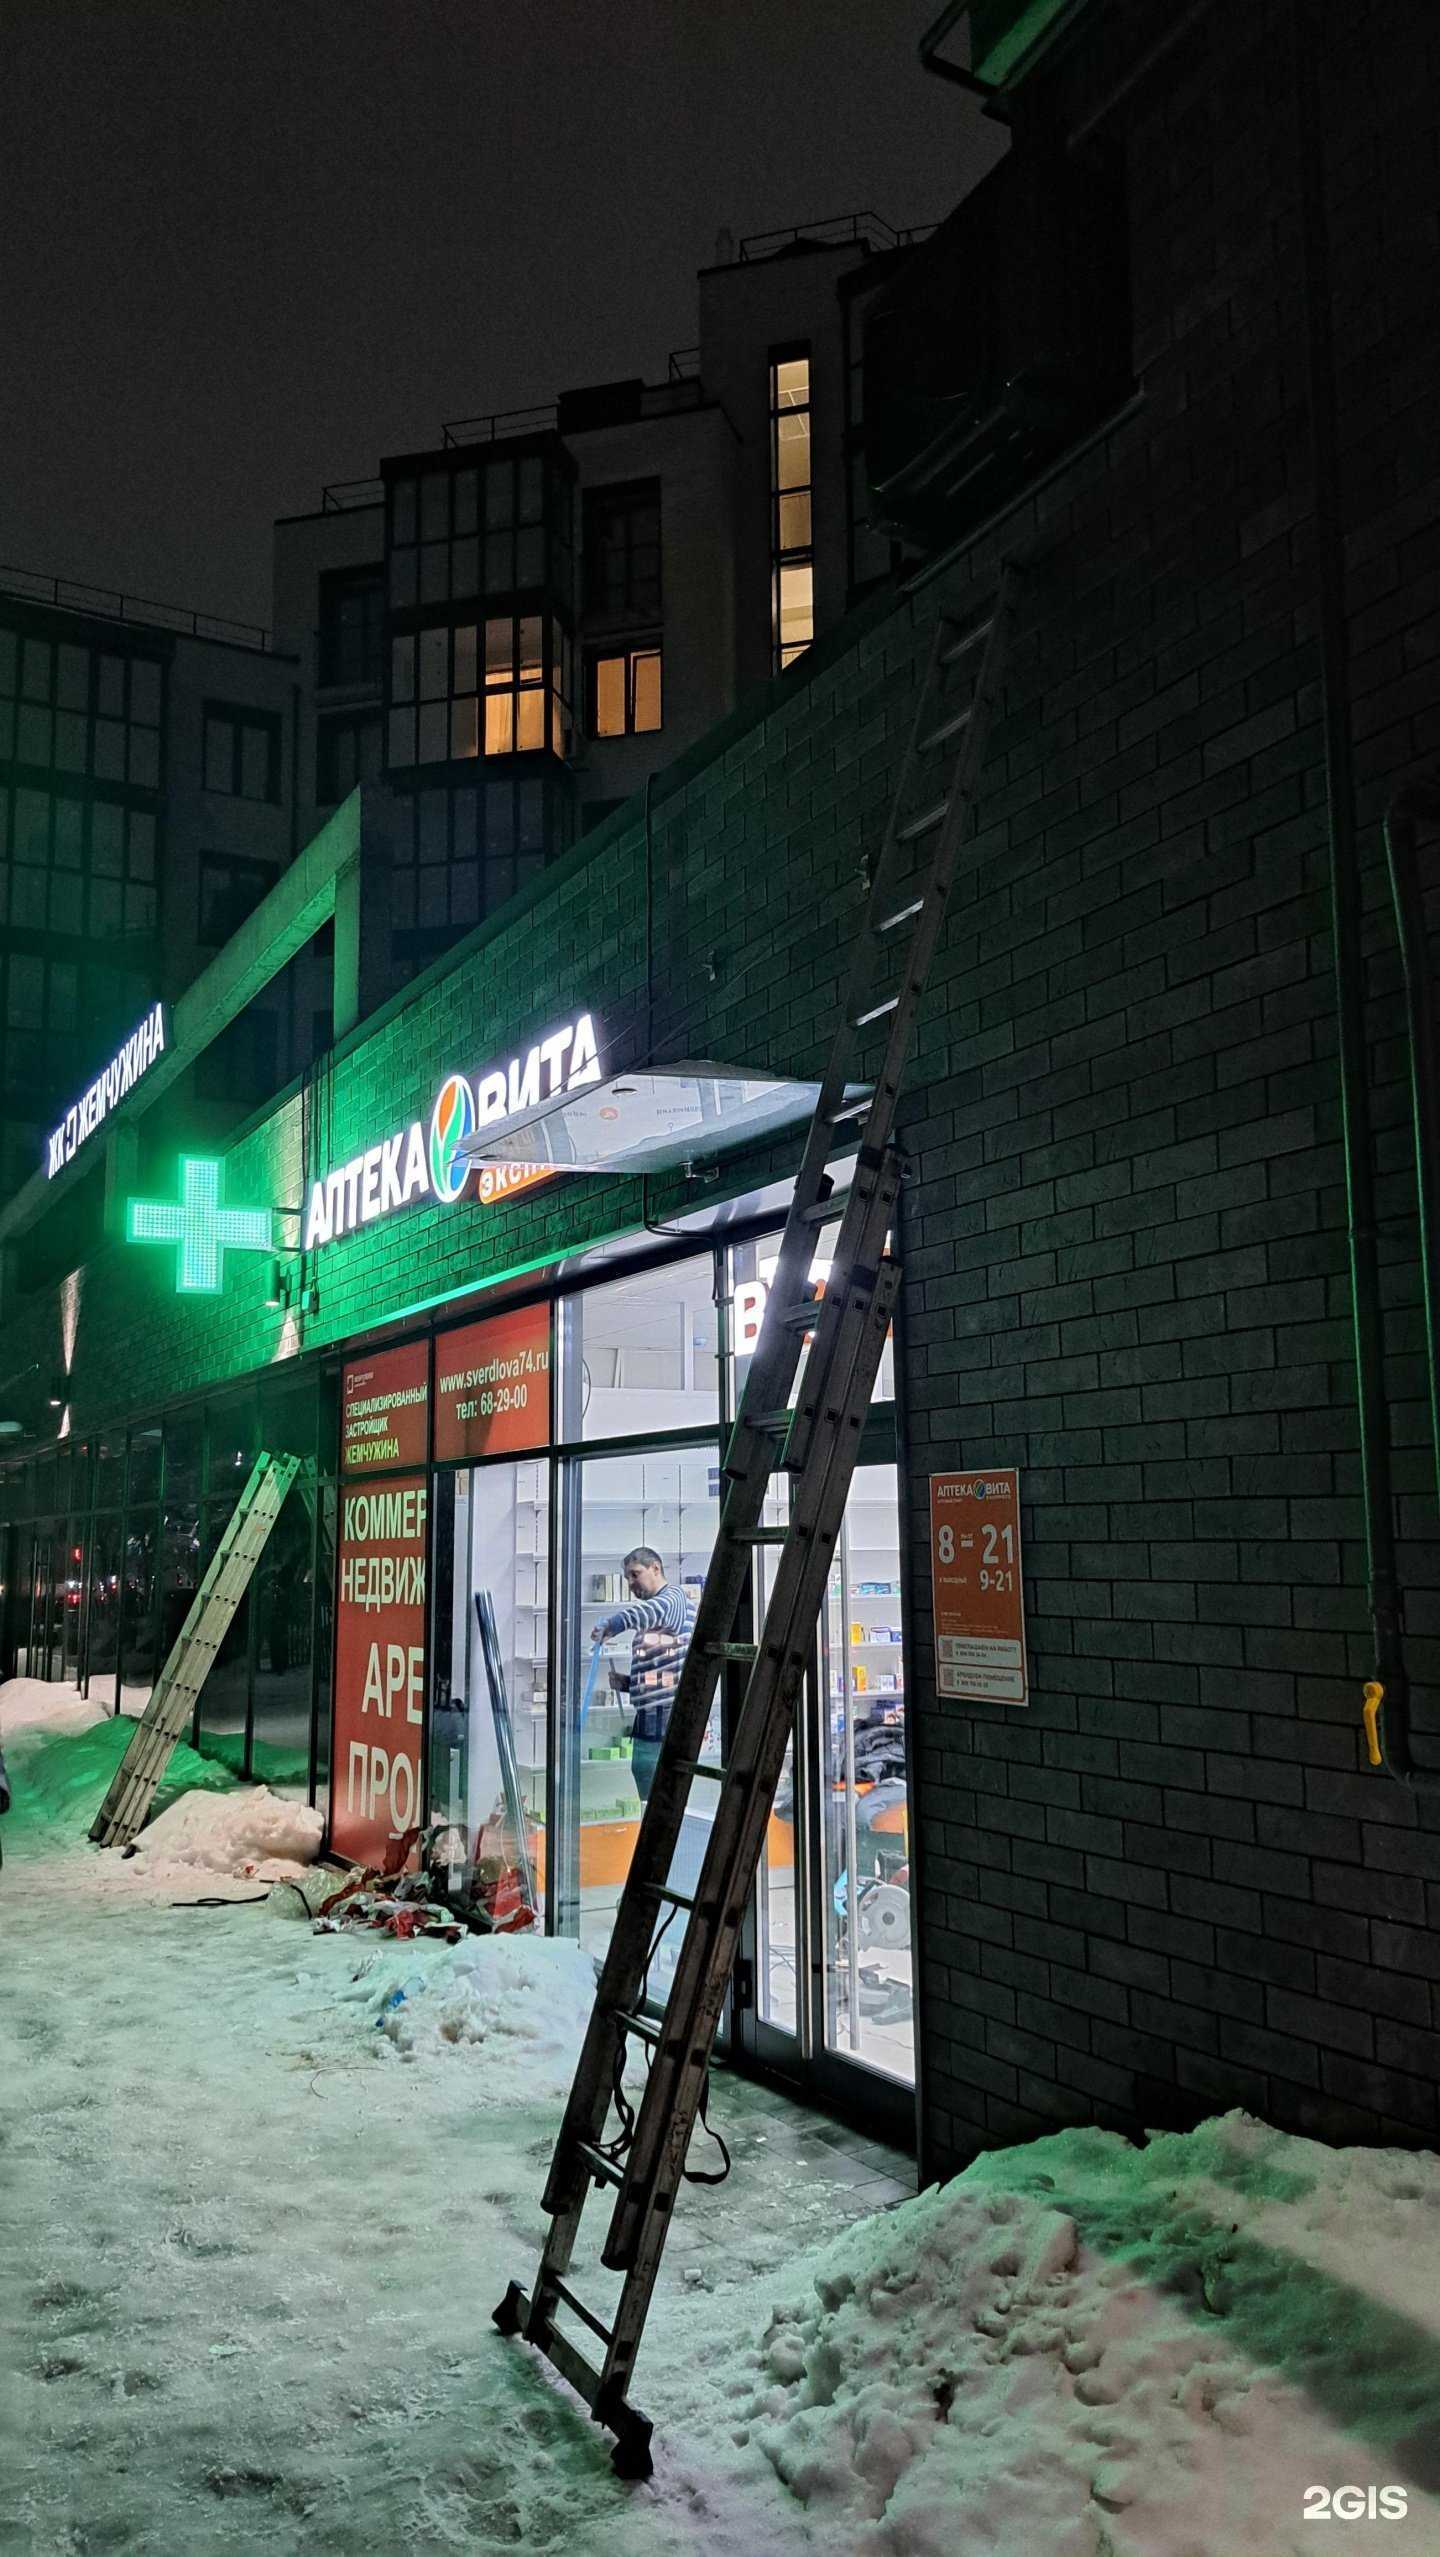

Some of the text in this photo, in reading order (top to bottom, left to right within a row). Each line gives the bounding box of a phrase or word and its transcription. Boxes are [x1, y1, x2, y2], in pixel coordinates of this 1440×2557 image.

[77, 1002, 165, 1146] ЖЕМЧУЖИНА
[305, 1014, 602, 1250] АПТЕКА ВИТА
[440, 1349, 549, 1394] www.sverdlova74.ru
[346, 1382, 428, 1418] СПЕЦИАЛИЗИРОВАННЫЙ
[456, 1384, 527, 1420] тел: 68-29-00
[345, 1416, 389, 1439] ЗАСТРОЙЩИК
[345, 1438, 399, 1465] ЖЕМЧУЖИНА
[937, 1482, 1011, 1497] АПТЕКА ВИТА
[344, 1488, 427, 1542] КОММЕР
[938, 1524, 955, 1564] 8
[981, 1523, 1014, 1565] 21
[340, 1556, 425, 1613] НЕДВИЖ
[979, 1569, 1013, 1592] 9-21
[347, 1740, 422, 1834] ПРО
